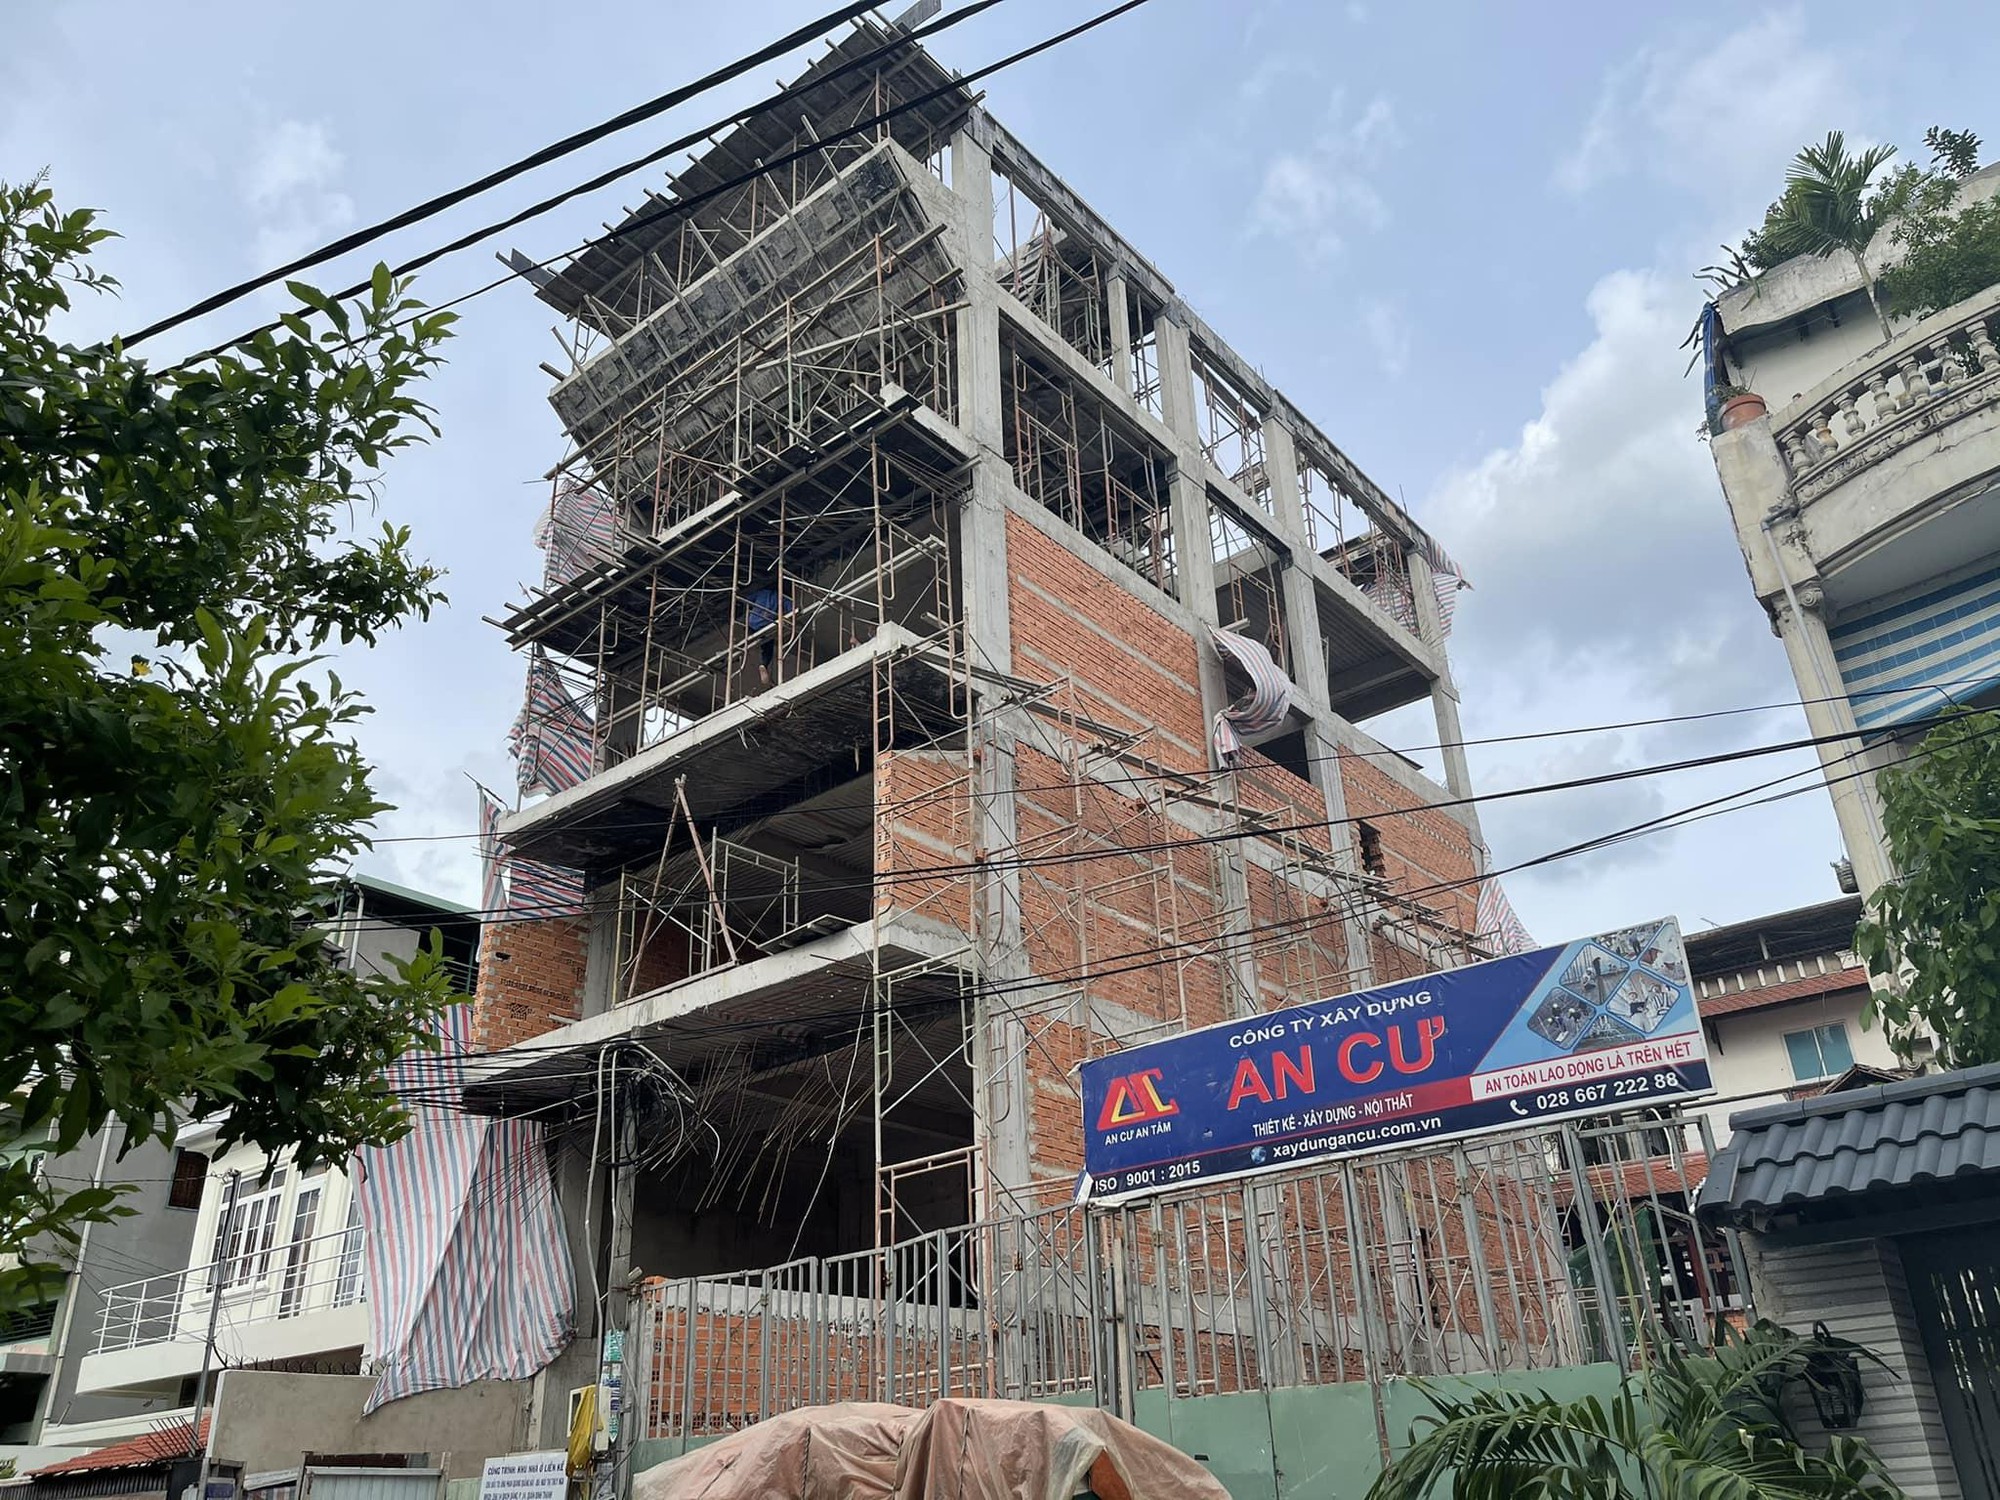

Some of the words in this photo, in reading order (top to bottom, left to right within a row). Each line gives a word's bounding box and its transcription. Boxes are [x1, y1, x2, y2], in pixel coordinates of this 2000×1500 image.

[1229, 1024, 1285, 1048] CÔNG
[1289, 1016, 1315, 1033] TY
[1320, 1006, 1361, 1028] XÂY
[1367, 990, 1432, 1016] DỰNG
[1226, 1044, 1316, 1111] AN
[1337, 1015, 1445, 1084] CƯ
[1485, 1076, 1501, 1094] AN
[1504, 1069, 1538, 1089] TOÀN
[1540, 1065, 1565, 1083] LAO
[1567, 1057, 1604, 1079] ĐỘNG
[1607, 1050, 1625, 1070] LÀ
[1626, 1045, 1663, 1066] TRÊN
[1536, 1091, 1570, 1111] 028
[1574, 1084, 1606, 1103] 667
[1613, 1076, 1649, 1097] 222
[1654, 1071, 1679, 1089] 88
[1105, 1133, 1118, 1146] AN
[1119, 1129, 1135, 1142] CƯ
[1135, 1126, 1149, 1139] AN
[1151, 1121, 1172, 1135] TÂM
[1302, 1109, 1325, 1128] XÂY
[1325, 1105, 1356, 1126] DỰNG
[1364, 1098, 1384, 1117] NỘI
[1272, 1116, 1441, 1159] xaydungancu.com.vn
[1095, 1177, 1118, 1193] ISO
[1126, 1168, 1156, 1187] 9001
[1168, 1160, 1201, 1179] 2015
